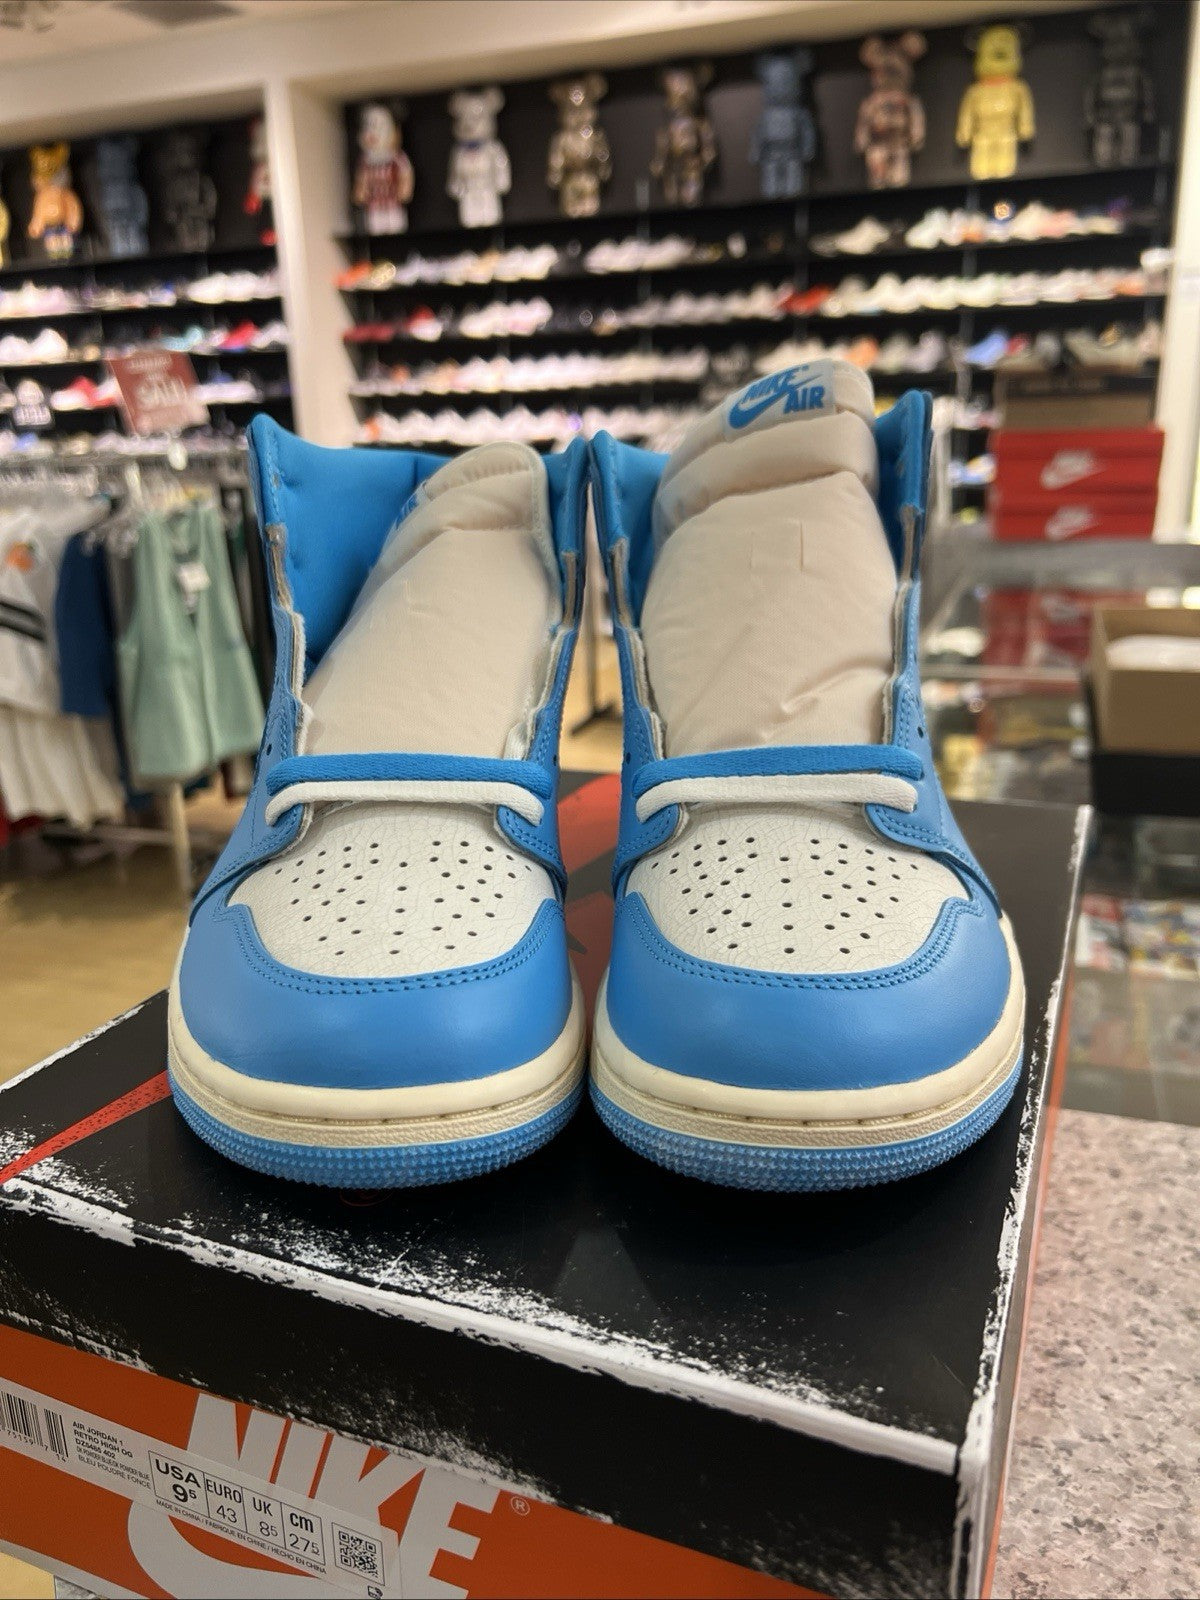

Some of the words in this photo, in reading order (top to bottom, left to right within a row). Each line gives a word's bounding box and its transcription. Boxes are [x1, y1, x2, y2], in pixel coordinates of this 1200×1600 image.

[783, 385, 825, 414] AIR
[73, 1421, 85, 1431] AIR
[87, 1427, 118, 1444] JORDAN
[73, 1429, 99, 1445] RETRO
[100, 1440, 120, 1453] HIGH
[155, 1459, 202, 1489] USA
[206, 1479, 242, 1504] EURO
[252, 1497, 273, 1517] UK
[289, 1513, 314, 1534] cm
[216, 1505, 237, 1524] 43
[156, 1499, 174, 1512] MADE
[181, 1510, 201, 1522] CHINA
[271, 1547, 295, 1561] HECHO
[296, 1558, 305, 1566] EN
[306, 1561, 327, 1575] CHINA
